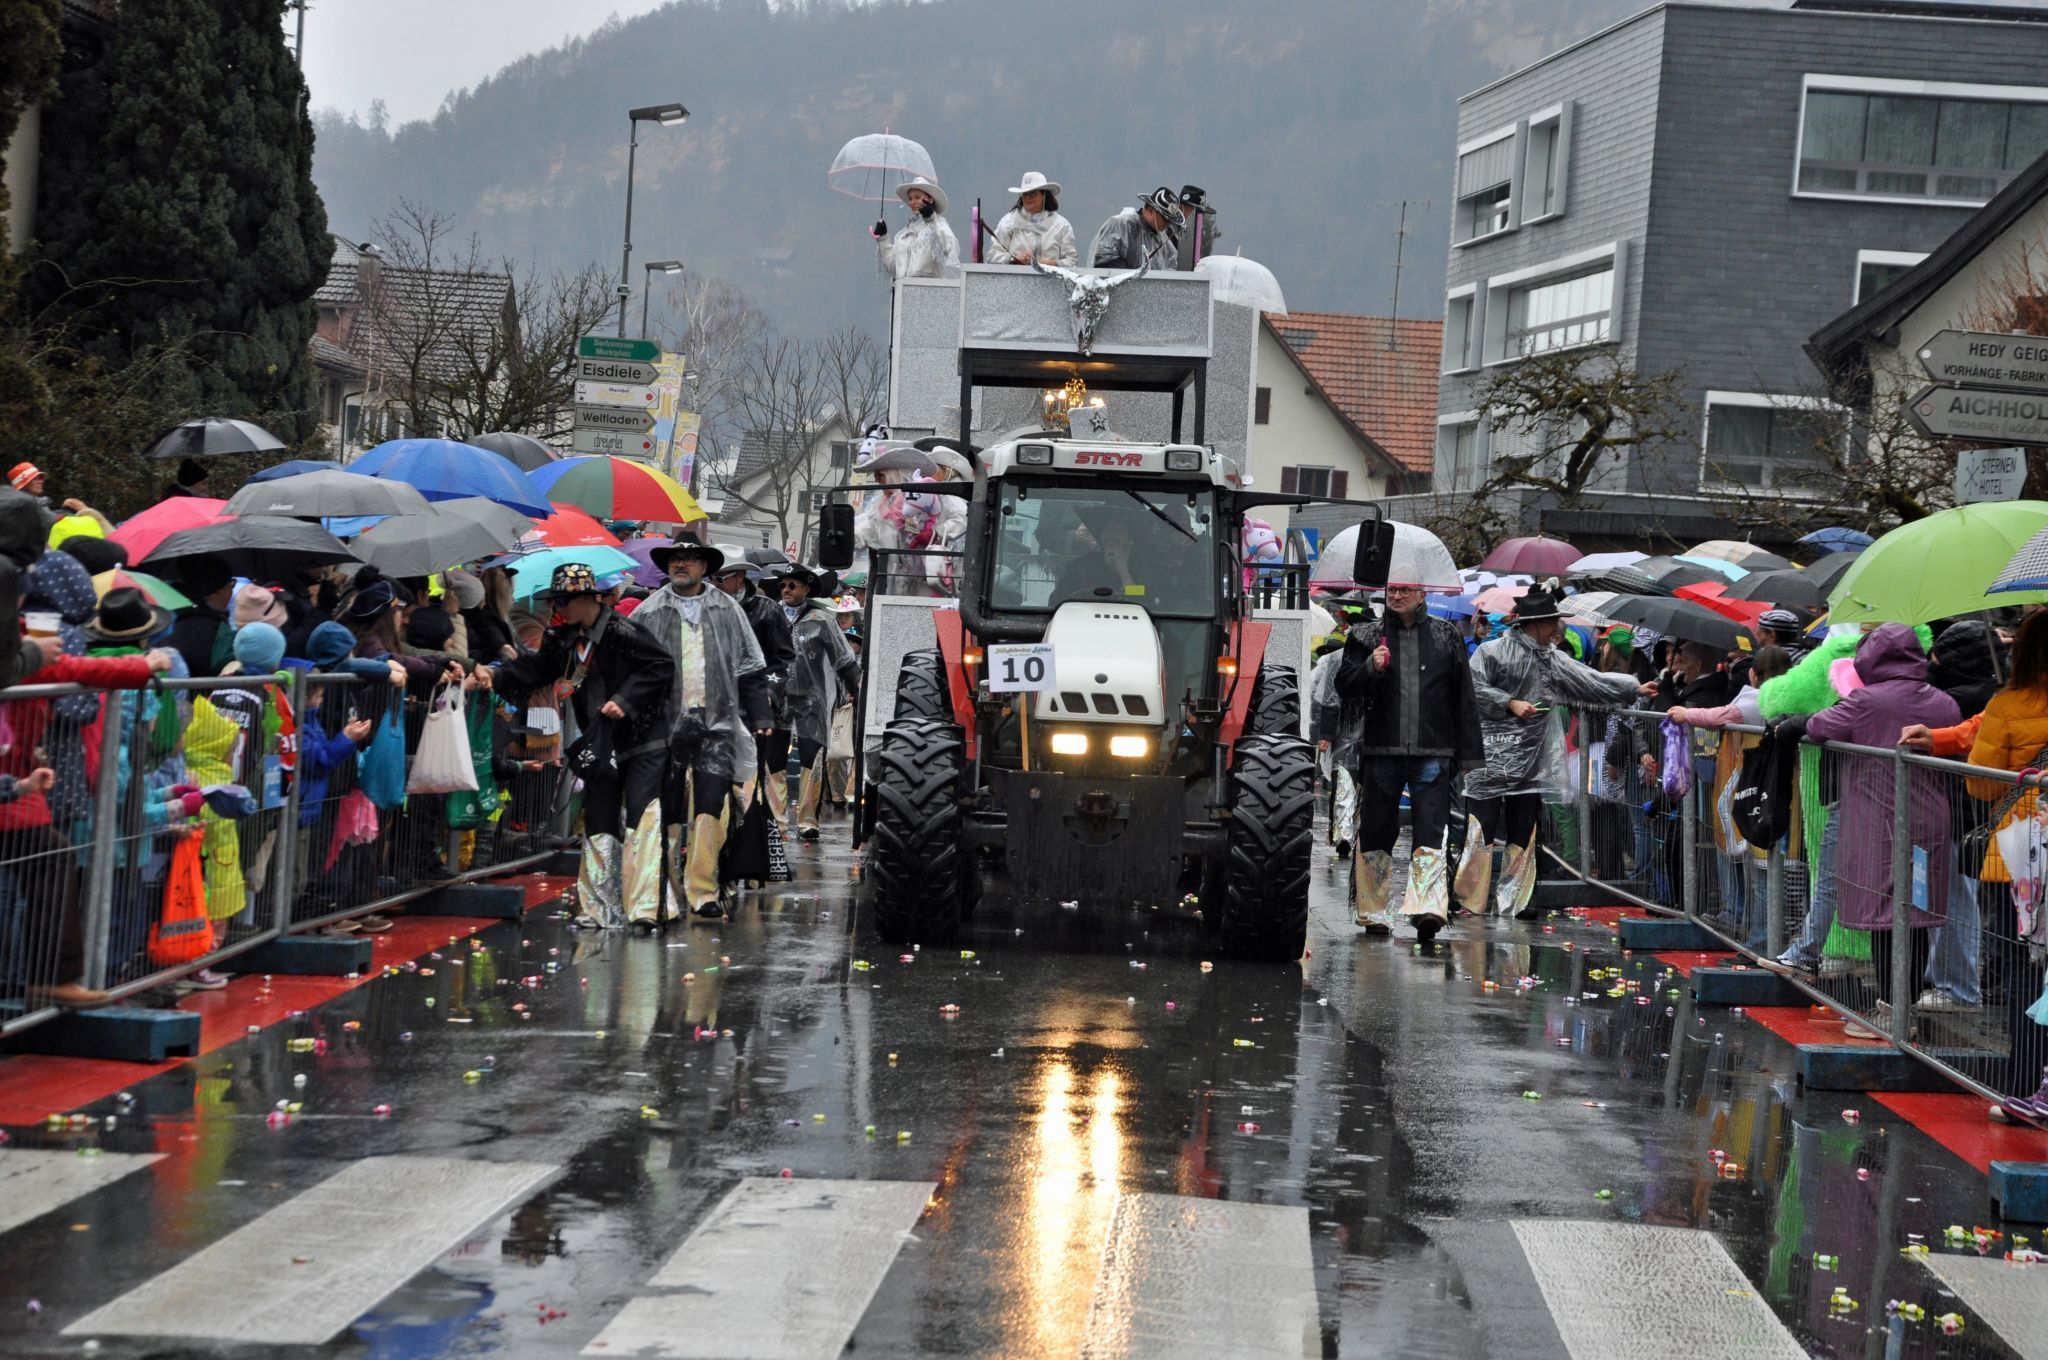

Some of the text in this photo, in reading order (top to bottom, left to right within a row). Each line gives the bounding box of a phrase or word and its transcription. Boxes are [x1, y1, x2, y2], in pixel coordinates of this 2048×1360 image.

[594, 339, 634, 349] Dorfzentrum
[1969, 343, 2006, 358] HEDY
[595, 348, 631, 357] Marktplatz
[583, 362, 641, 379] Eisdiele
[1948, 397, 2048, 421] AICHHOL
[582, 412, 639, 425] Weltladen
[1074, 451, 1143, 467] STEYR
[1981, 457, 2017, 474] STERNEN
[1980, 479, 2003, 495] HOTEL
[1002, 656, 1045, 683] 10
[767, 818, 781, 880] BREGENZ
